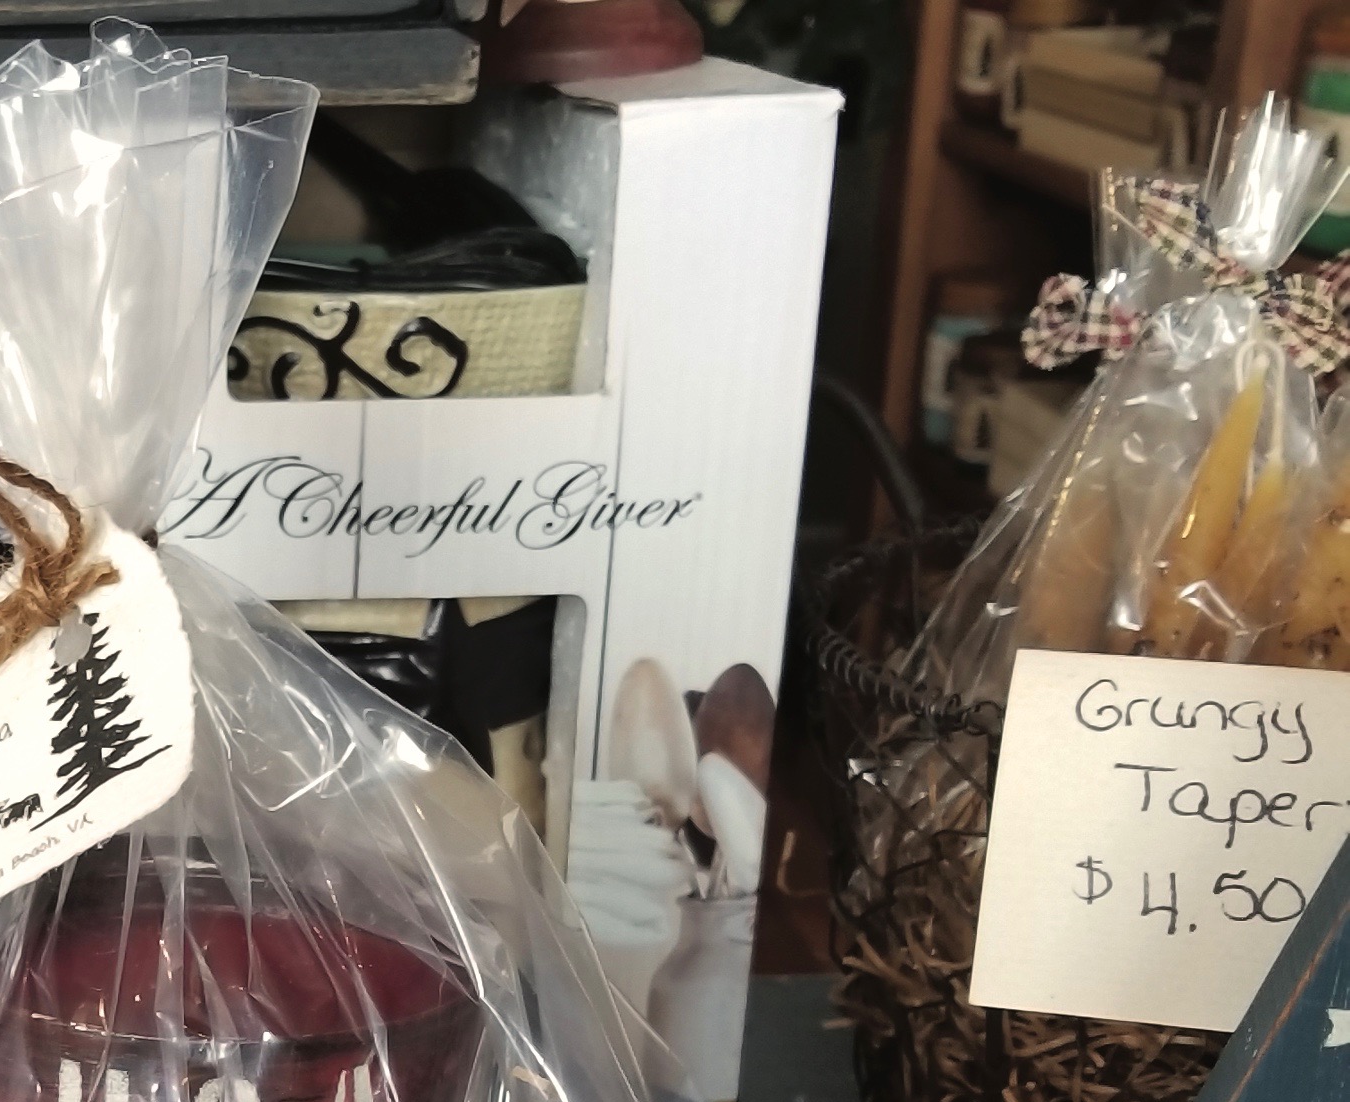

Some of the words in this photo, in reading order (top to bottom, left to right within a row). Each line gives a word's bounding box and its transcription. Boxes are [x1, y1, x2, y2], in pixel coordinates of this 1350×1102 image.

[263, 462, 524, 558] Cheerful
[1075, 678, 1313, 765] Grungy
[1113, 763, 1350, 849] Taper
